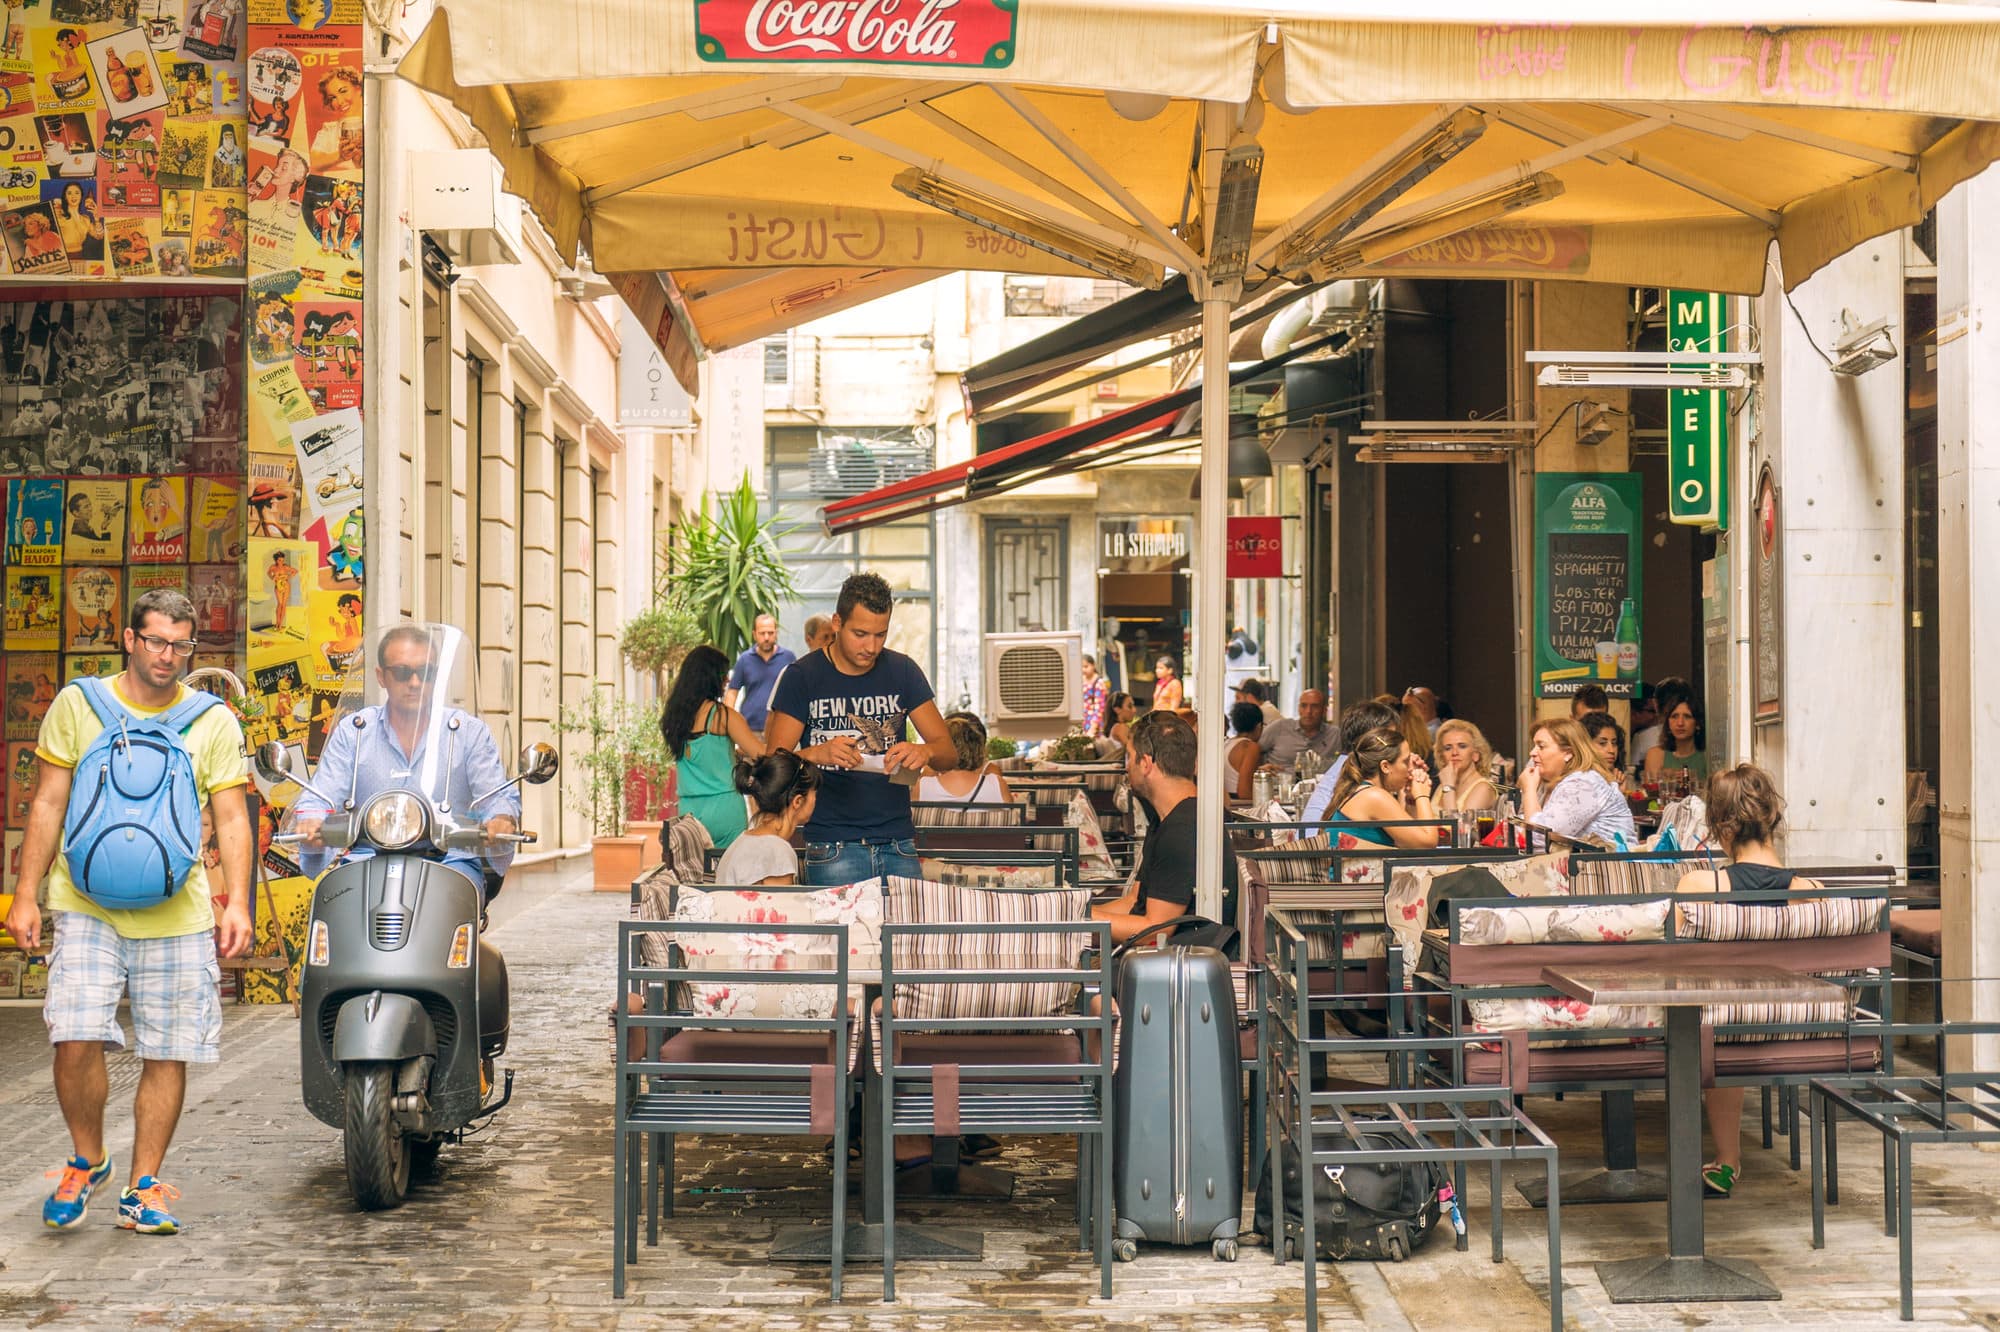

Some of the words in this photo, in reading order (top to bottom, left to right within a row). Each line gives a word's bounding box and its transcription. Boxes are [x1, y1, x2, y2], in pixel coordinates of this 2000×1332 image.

[745, 0, 957, 56] Coca-Cola
[302, 54, 340, 67] ΦΙΞ
[252, 234, 277, 249] ION
[1571, 497, 1607, 508] ALFA
[1104, 532, 1124, 558] LA
[1128, 532, 1185, 558] STAMPA
[1555, 562, 1625, 576] SPAGHETTI
[1552, 599, 1577, 614] SEA
[1581, 600, 1615, 617] FOOD
[1560, 615, 1615, 633] PIZZA
[1543, 683, 1583, 693] MONE
[809, 697, 846, 719] NEW
[851, 694, 902, 717] YORK
